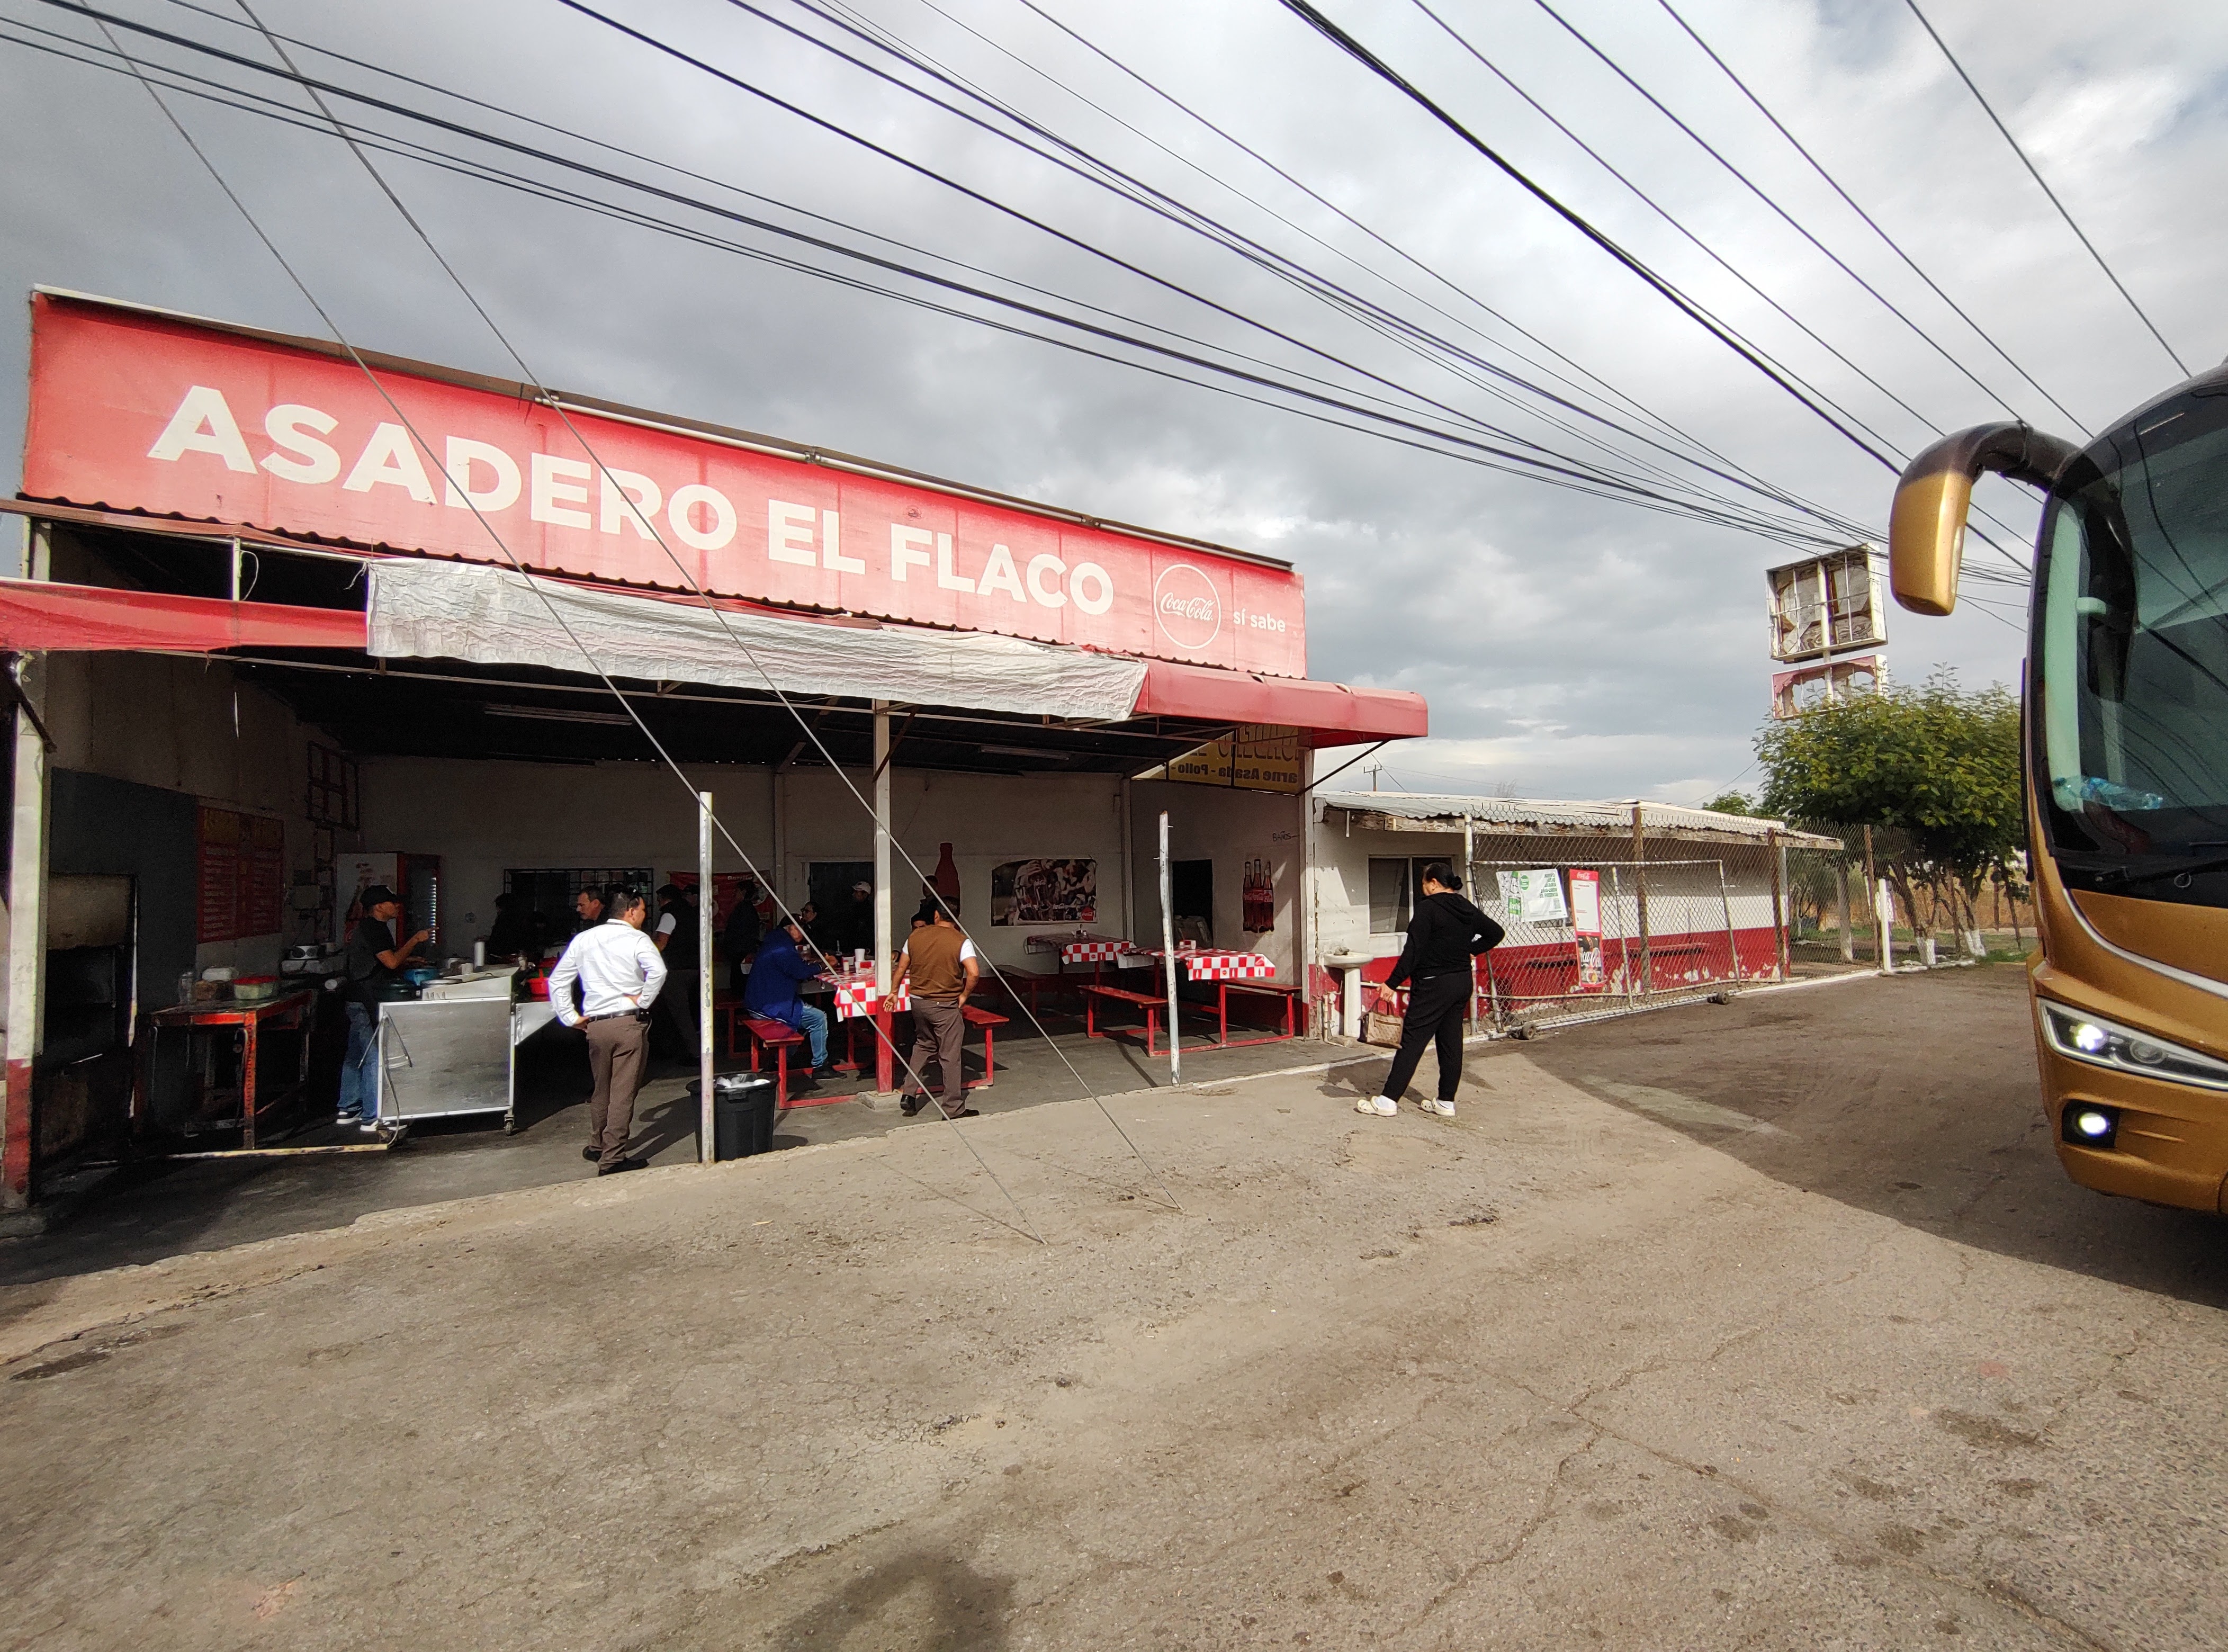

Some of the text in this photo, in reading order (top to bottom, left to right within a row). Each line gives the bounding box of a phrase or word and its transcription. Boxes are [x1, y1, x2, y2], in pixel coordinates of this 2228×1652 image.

[147, 385, 1115, 615] ASADERO EL FLACO
[1233, 607, 1287, 633] sí sabe
